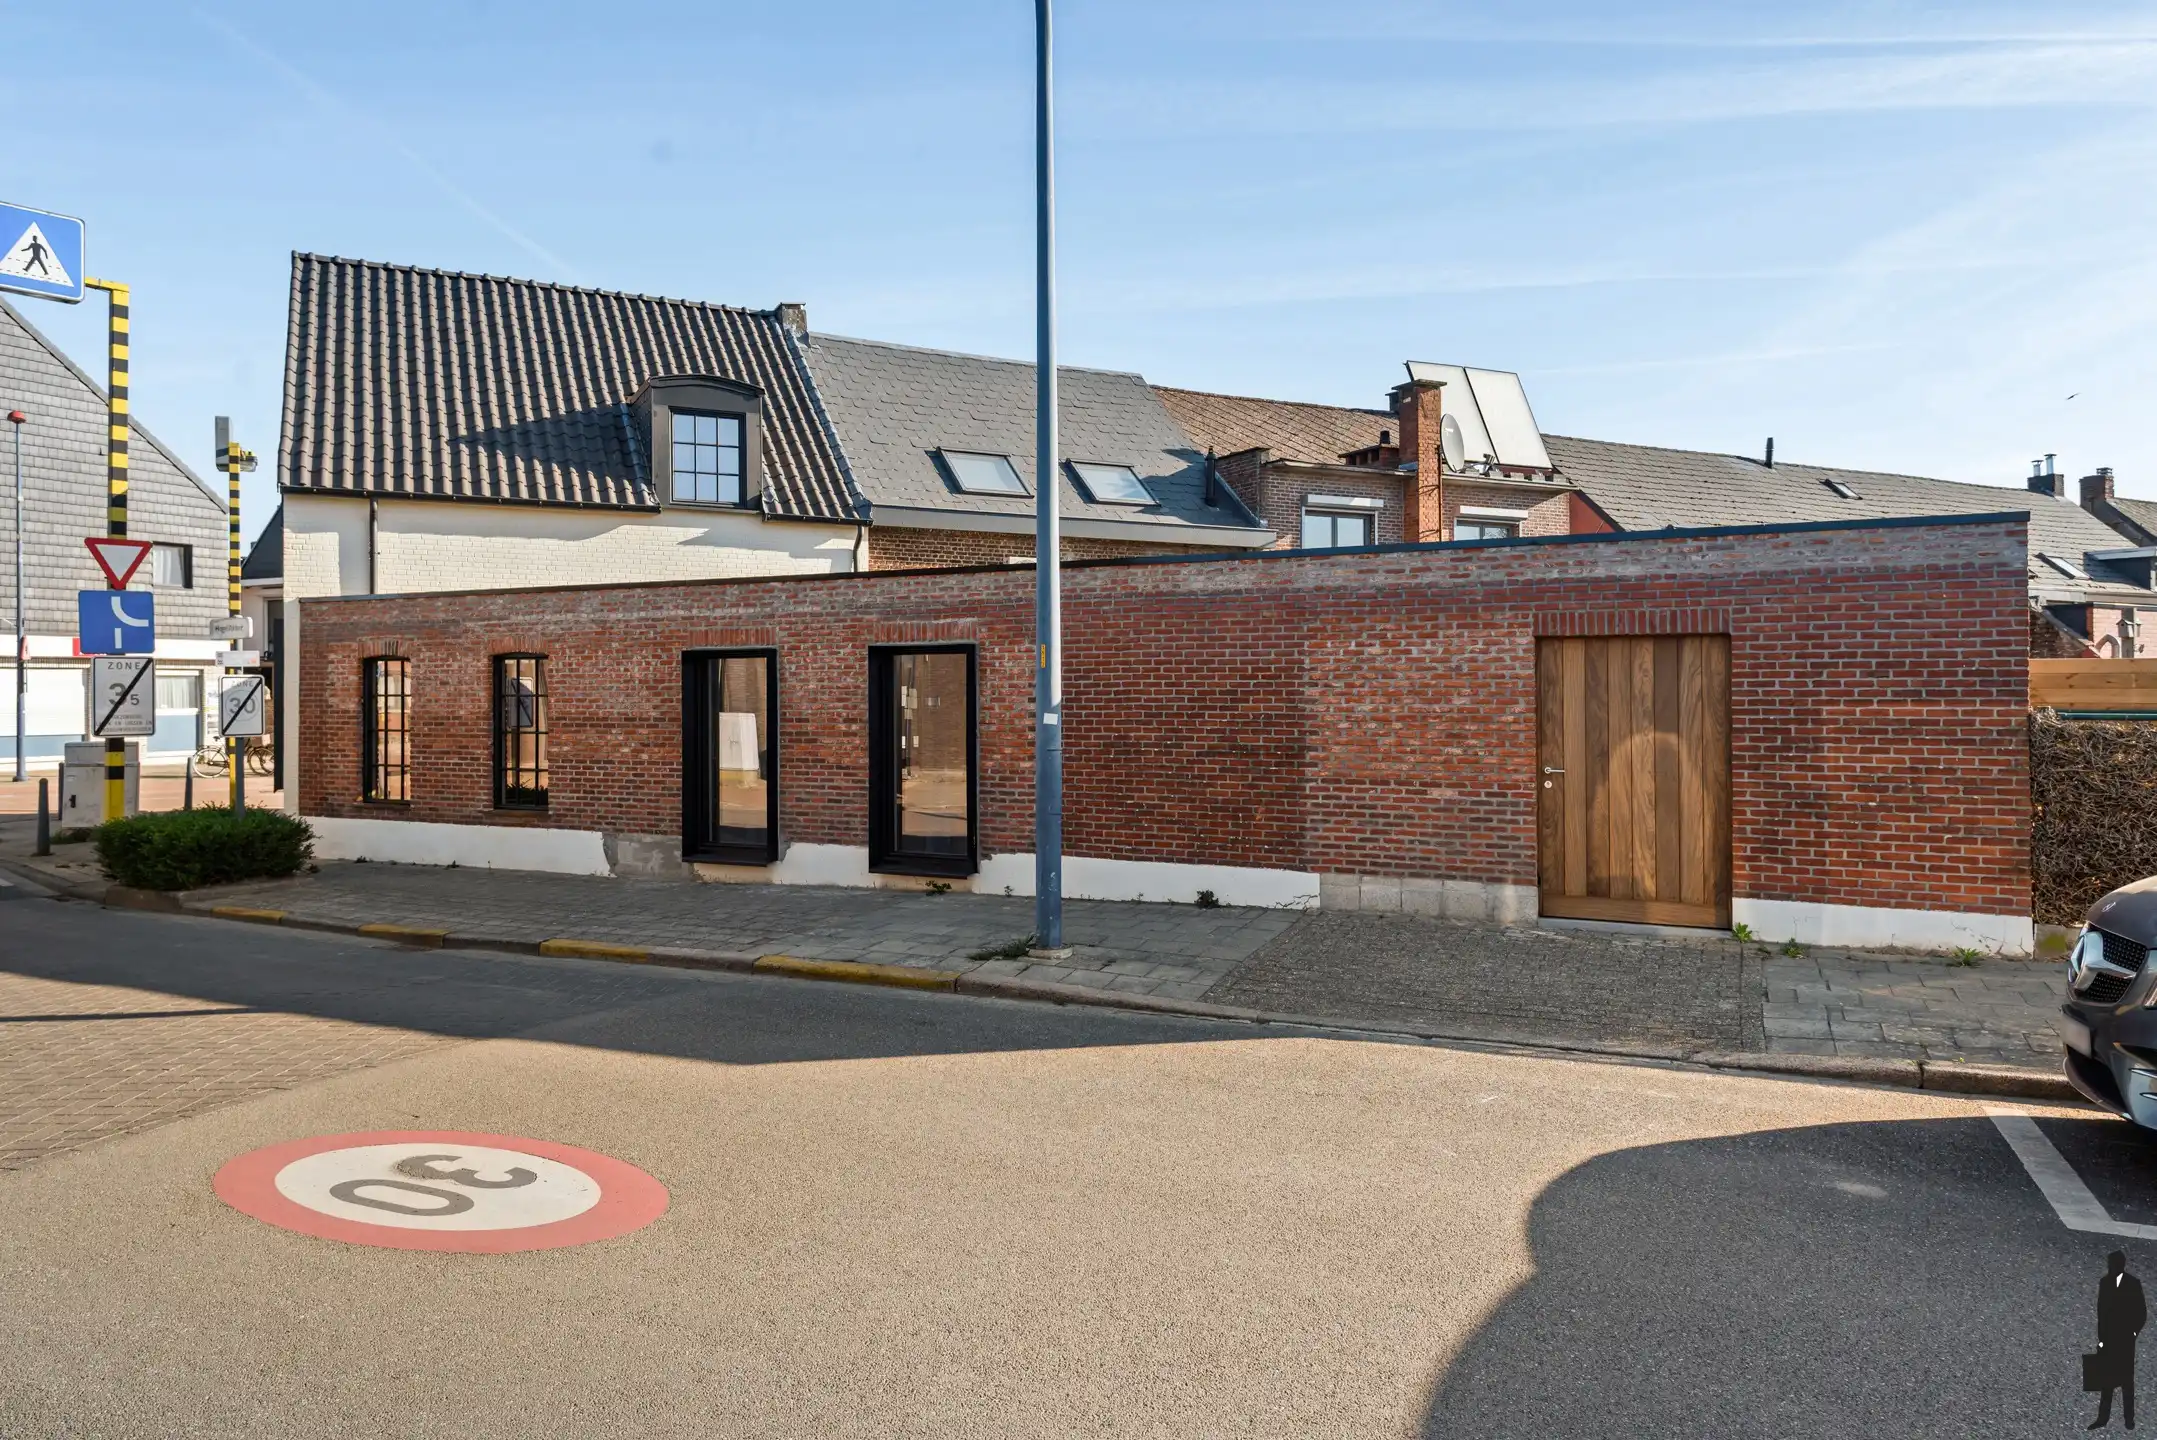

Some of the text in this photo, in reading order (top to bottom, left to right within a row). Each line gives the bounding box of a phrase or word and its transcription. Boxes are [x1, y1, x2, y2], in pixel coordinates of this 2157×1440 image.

[108, 661, 141, 670] ZONE
[229, 697, 256, 714] 30
[329, 1153, 538, 1217] 30
